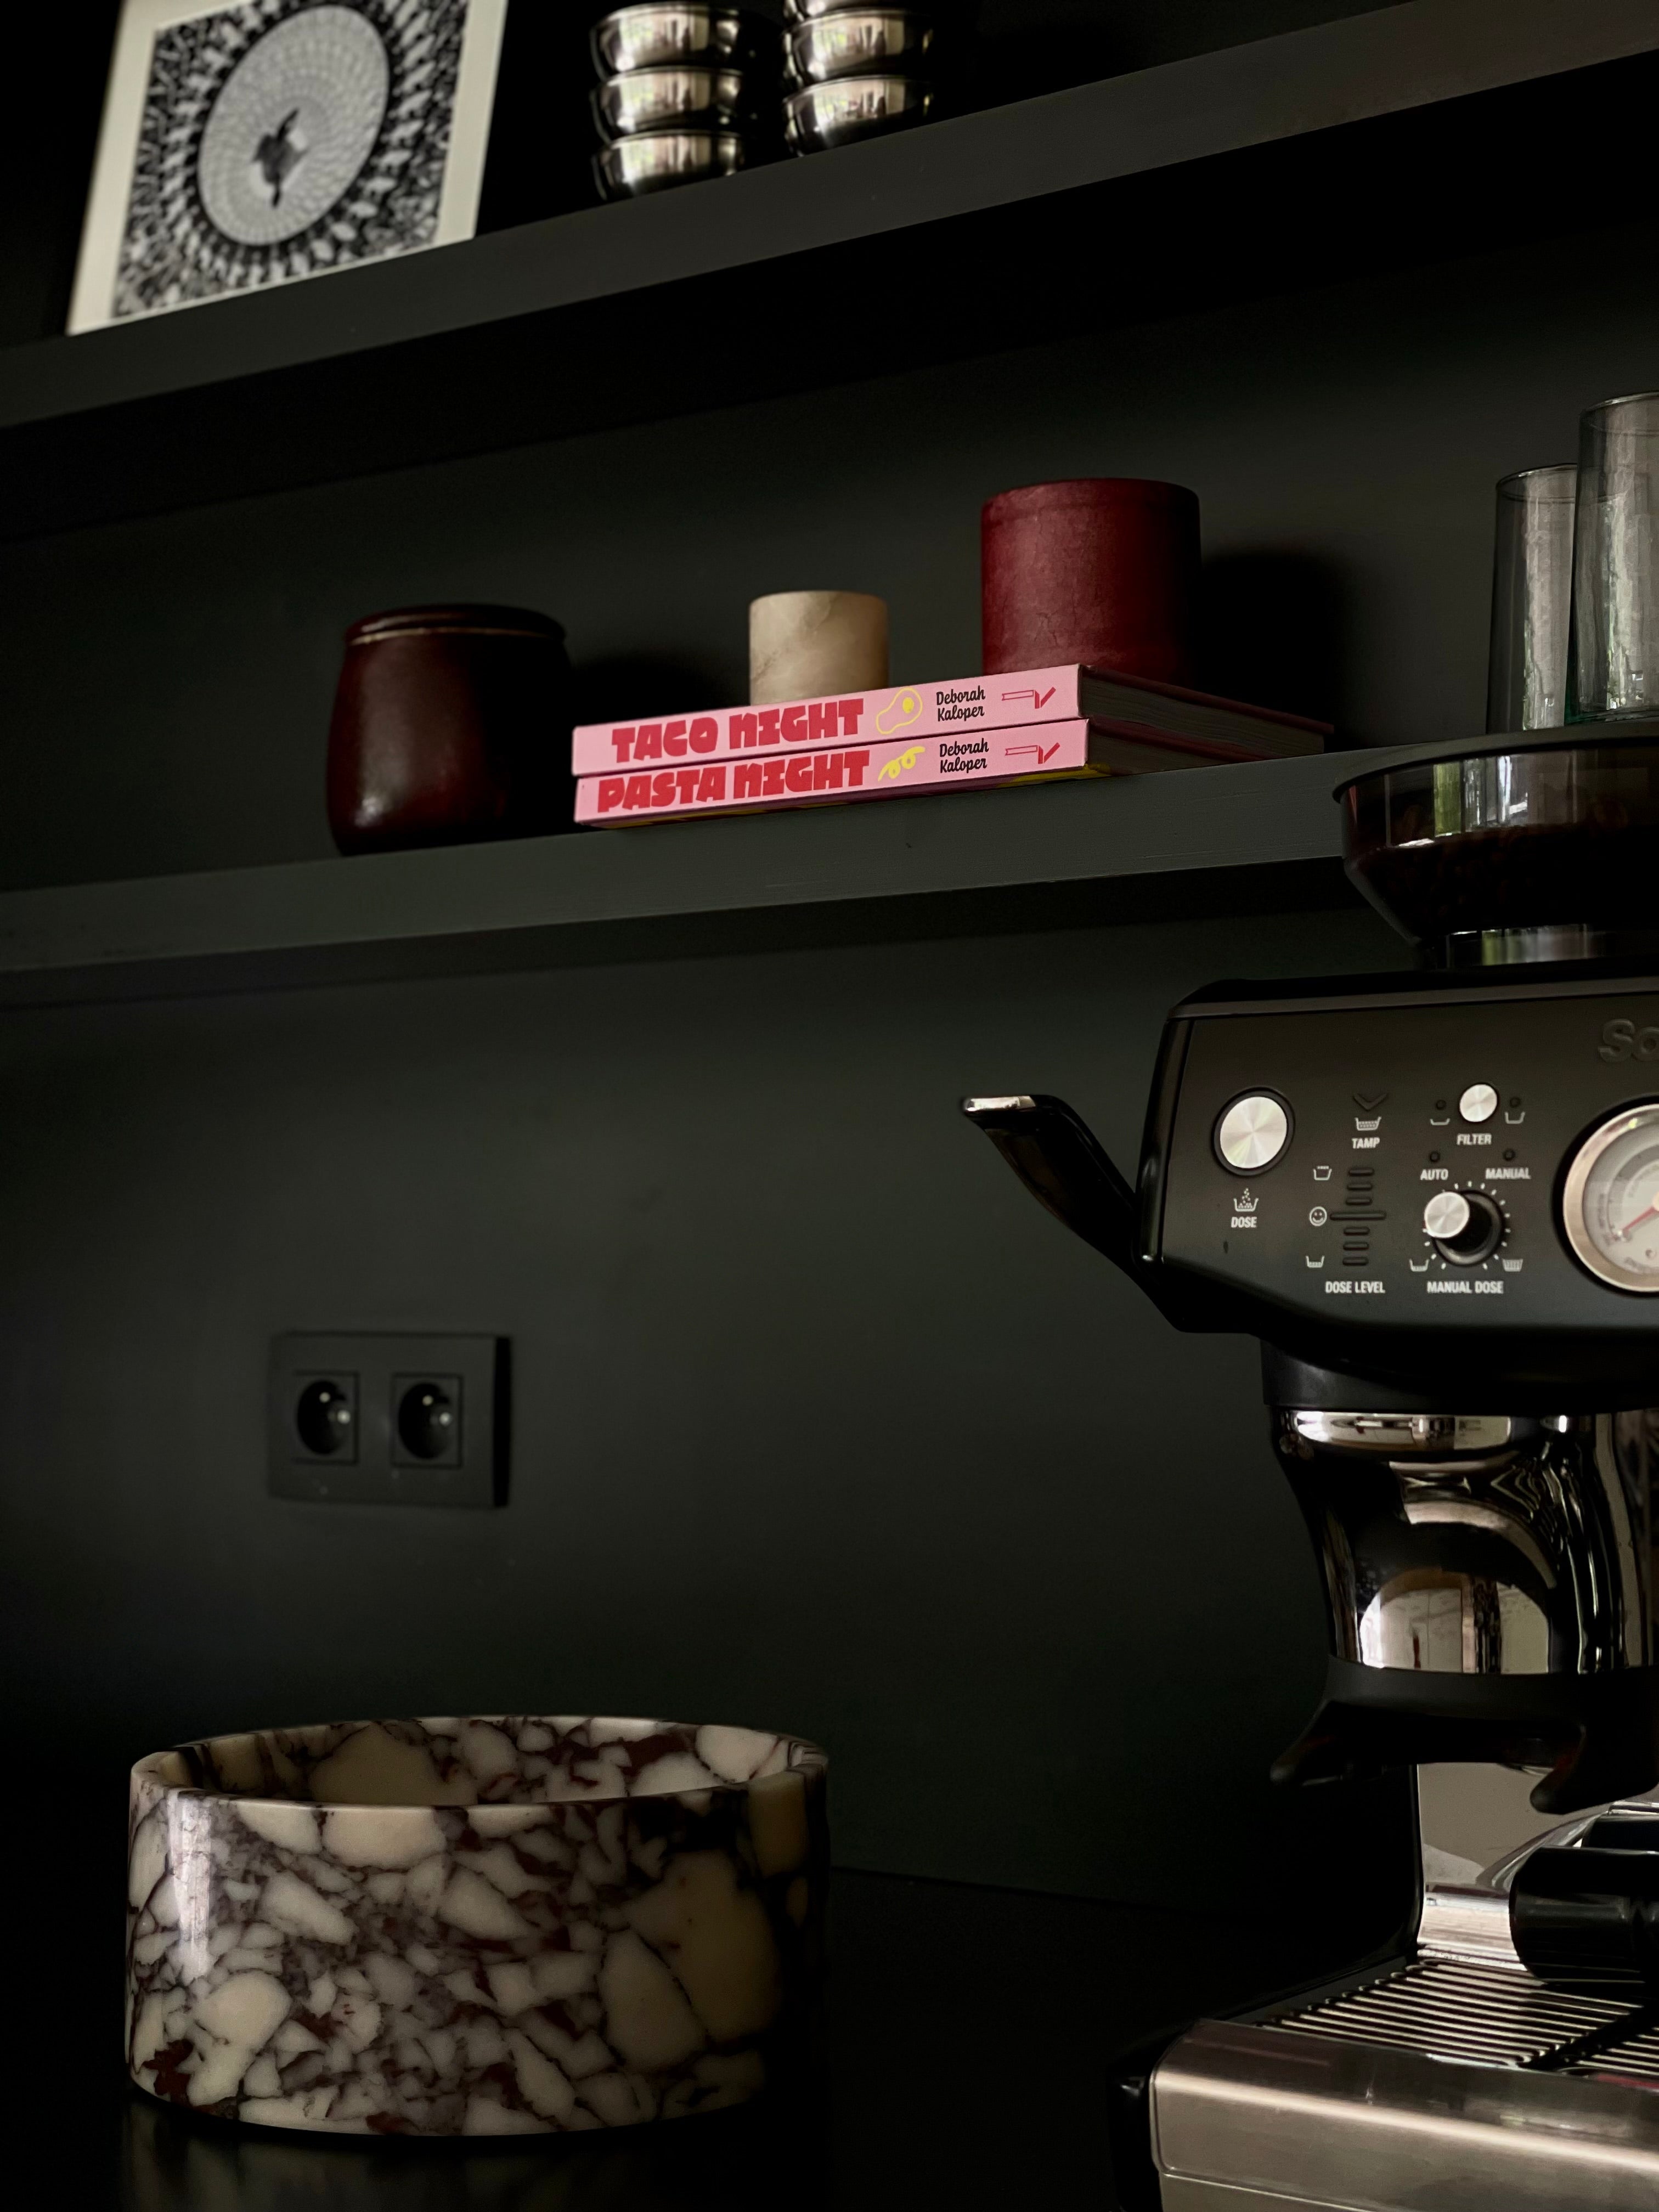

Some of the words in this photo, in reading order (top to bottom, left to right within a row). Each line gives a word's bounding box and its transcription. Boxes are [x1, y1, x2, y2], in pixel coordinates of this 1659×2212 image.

[936, 685, 986, 706] Deborah
[938, 705, 985, 721] Kaloper
[612, 718, 718, 762] TACO
[730, 699, 863, 749] NIGHT
[940, 738, 989, 757] Deborah
[940, 757, 988, 773] Kaloper
[597, 766, 726, 812] PASTA
[733, 751, 870, 799] NIGHT
[1352, 1137, 1380, 1149] TAMP
[1457, 1133, 1492, 1146] FILTER
[1420, 1169, 1448, 1181] AUTO
[1485, 1167, 1531, 1180] MANUAL
[1231, 1216, 1257, 1228] DOSE
[1325, 1281, 1352, 1294] DOSE
[1354, 1281, 1385, 1294] LEVEL
[1426, 1280, 1472, 1294] MANUAL
[1474, 1280, 1504, 1294] DOSE
